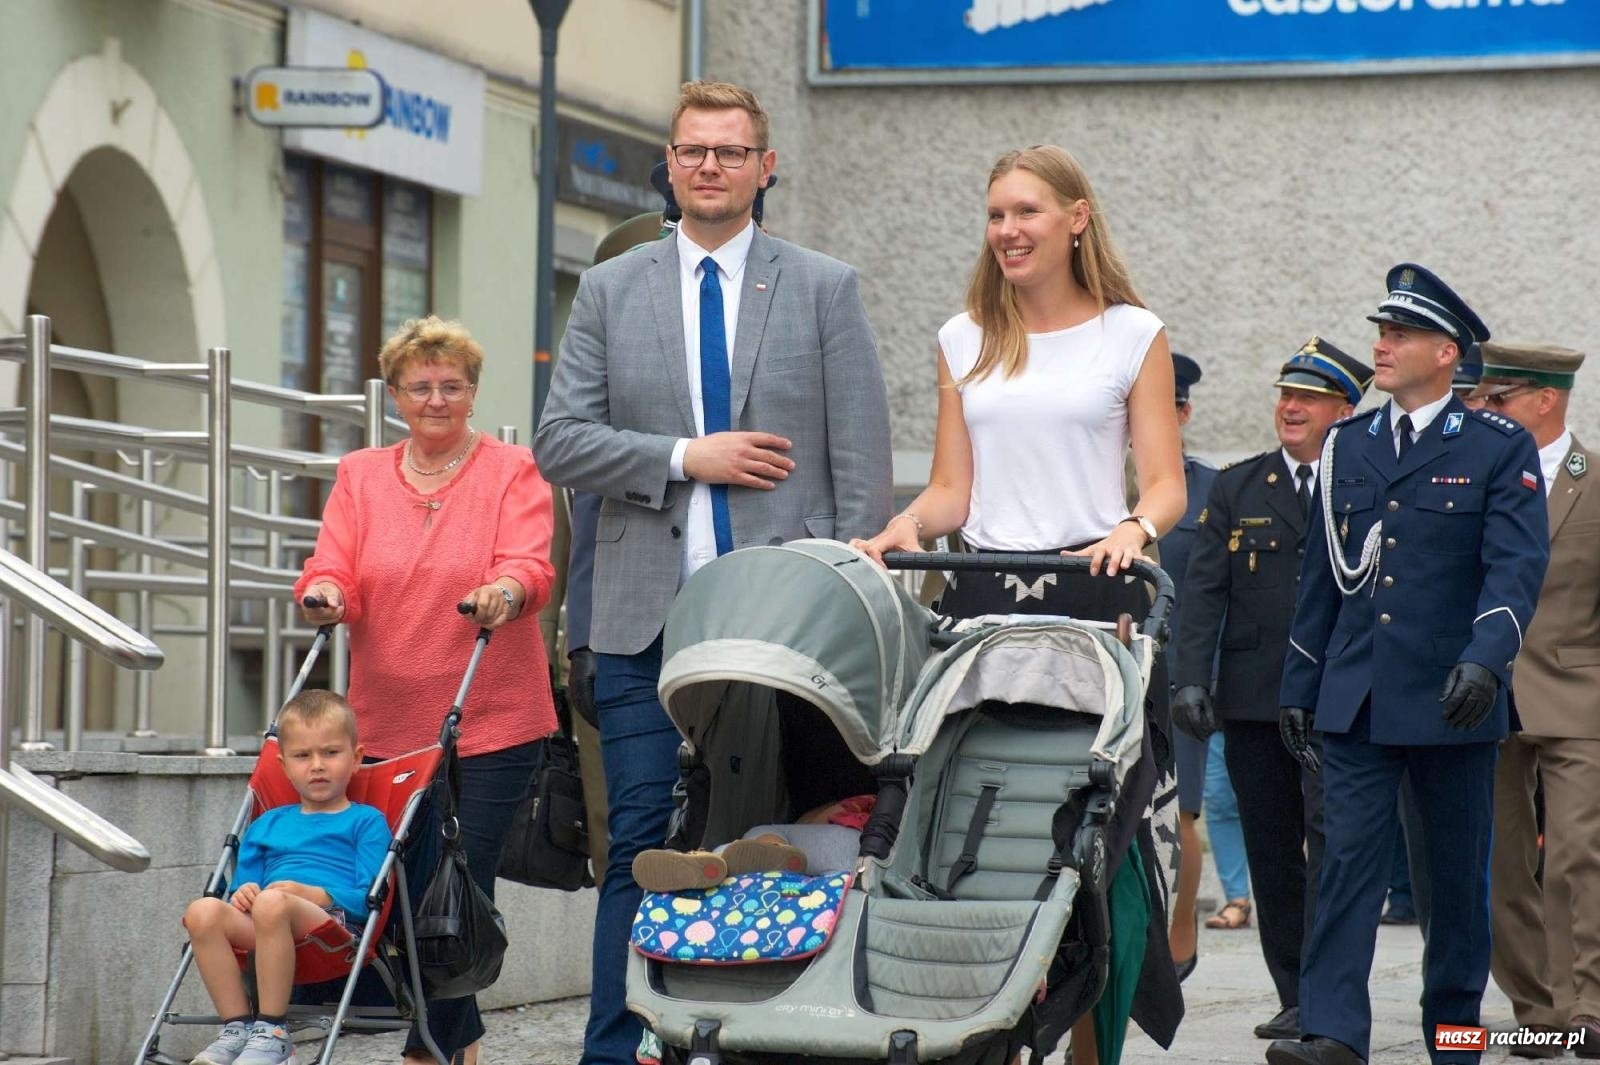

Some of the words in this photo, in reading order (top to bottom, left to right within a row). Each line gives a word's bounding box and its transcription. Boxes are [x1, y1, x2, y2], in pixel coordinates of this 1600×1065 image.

[283, 89, 370, 108] RAINBOW
[384, 85, 452, 144] AINBOW
[811, 674, 830, 690] GT
